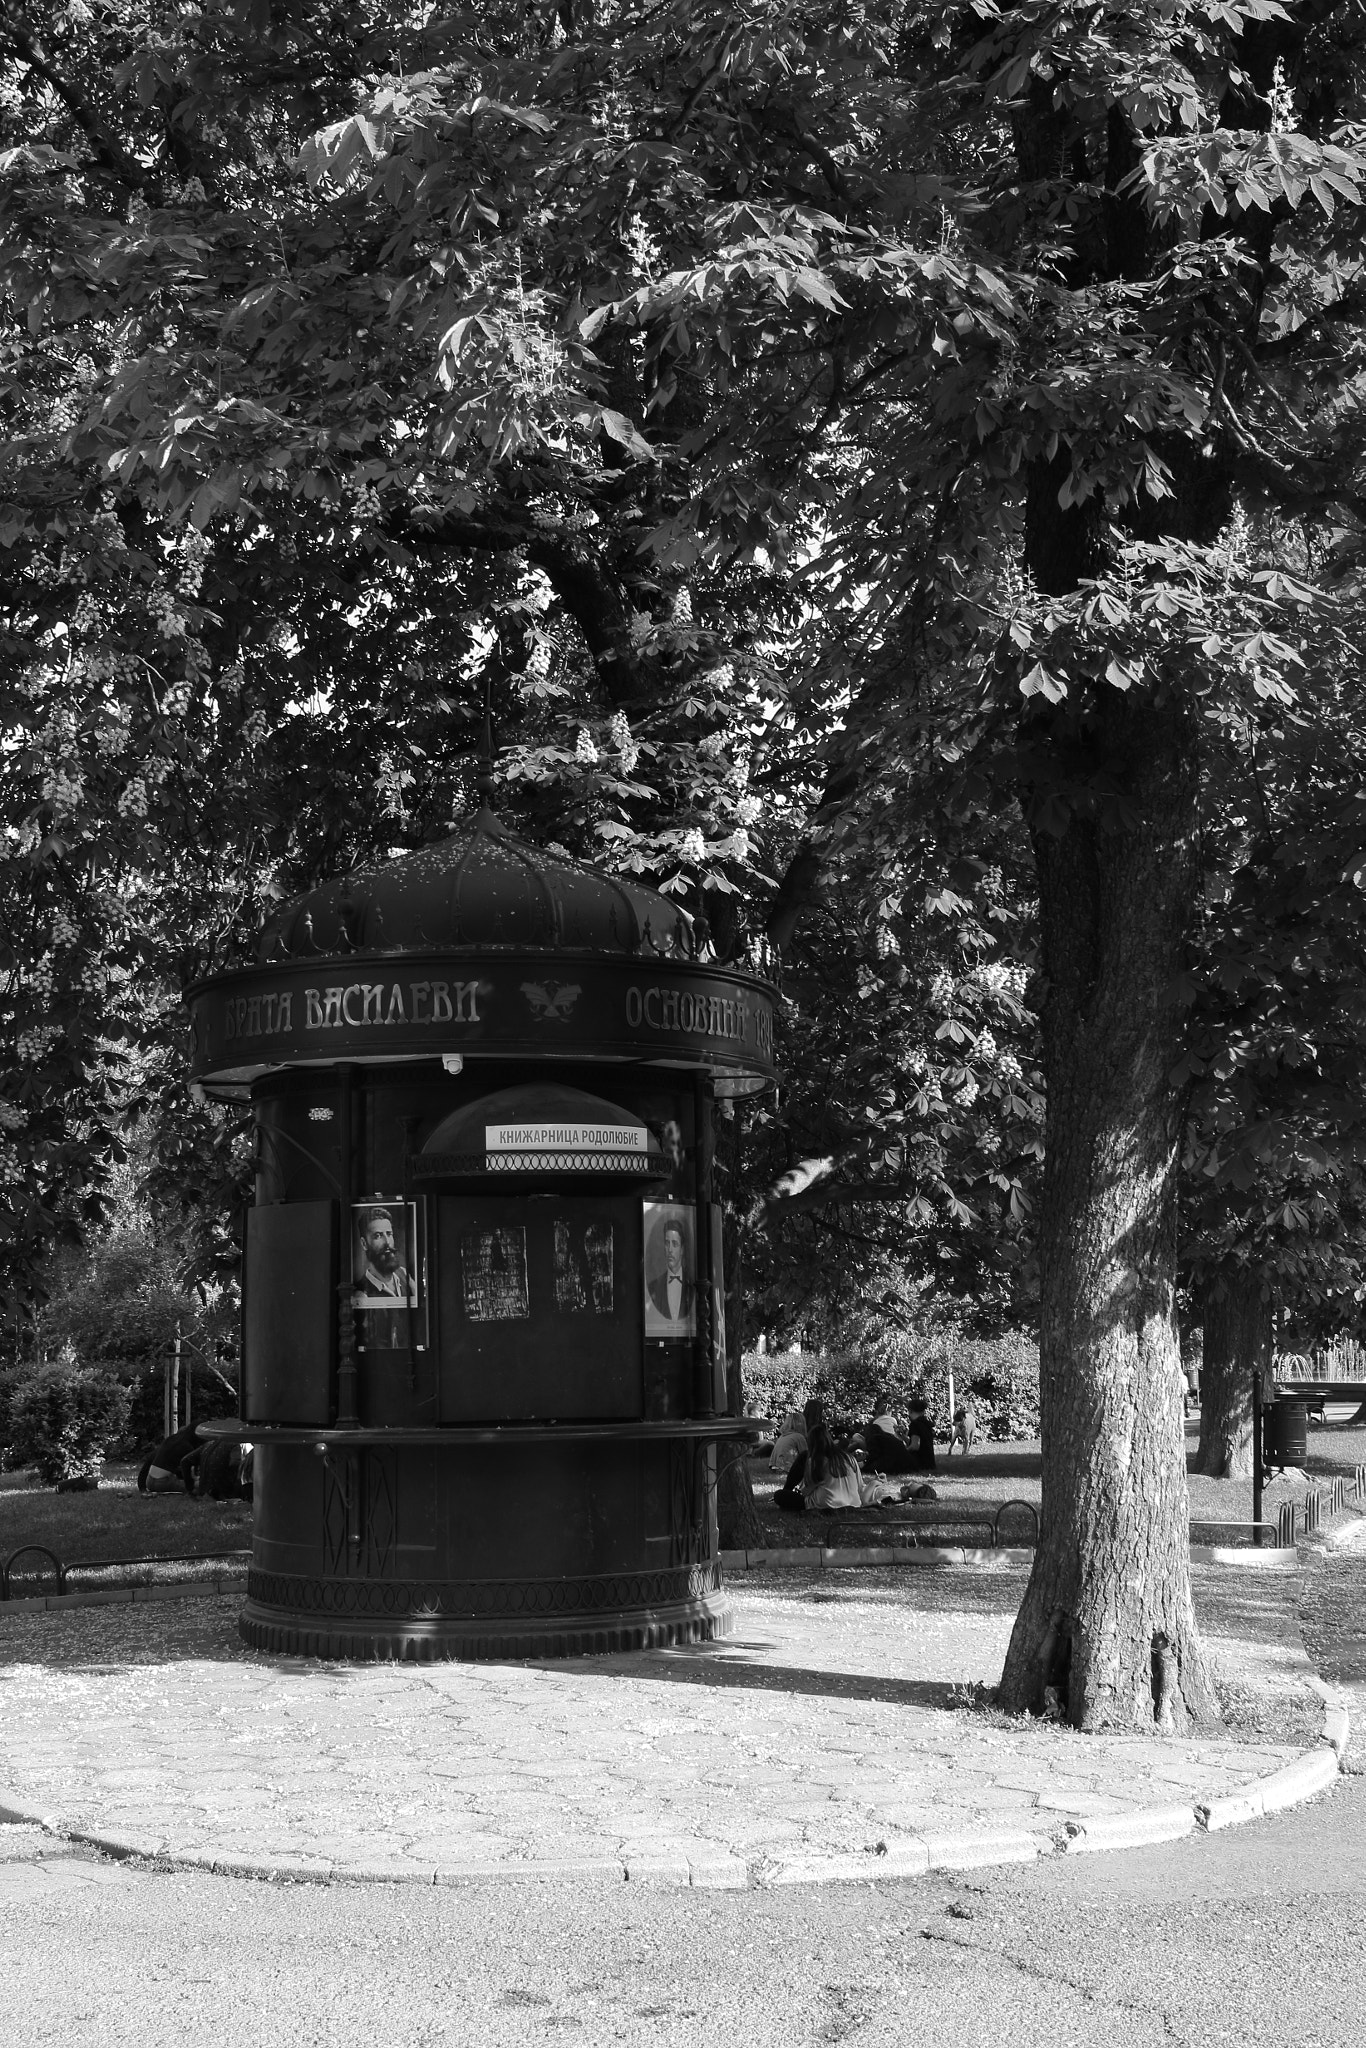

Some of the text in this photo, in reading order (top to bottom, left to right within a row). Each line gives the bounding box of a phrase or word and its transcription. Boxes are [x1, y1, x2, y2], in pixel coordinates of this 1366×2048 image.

[224, 981, 481, 1041] БРАТЯ ВАСИЛЕВИ
[625, 986, 748, 1042] ОСНОВАНА
[500, 1129, 639, 1146] КНИЖАРНИЦА РОДОЛЮБИЕ
